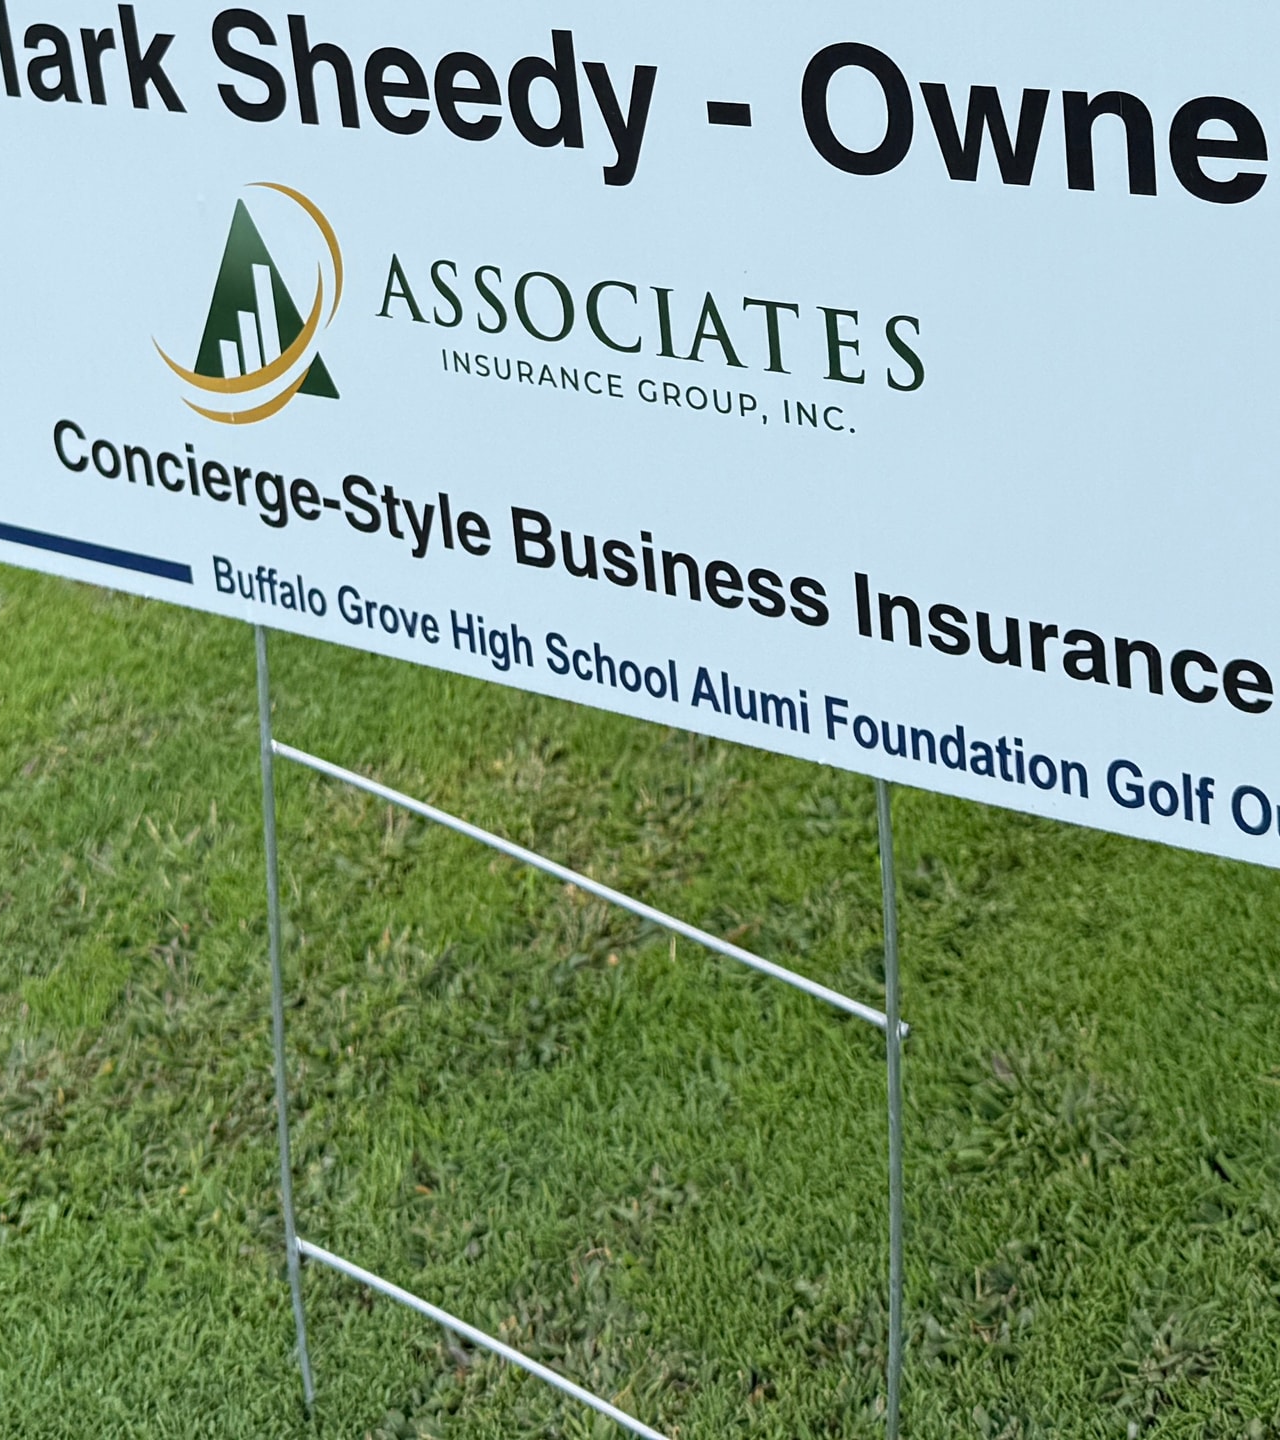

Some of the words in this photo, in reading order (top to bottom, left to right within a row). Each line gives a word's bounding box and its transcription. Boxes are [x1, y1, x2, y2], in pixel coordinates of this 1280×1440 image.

[212, 8, 657, 186] Sheedy
[707, 101, 752, 127] -
[376, 254, 924, 391] ASSOCIATES
[442, 349, 623, 398] INSURANCE
[638, 379, 767, 424] GROUP,
[784, 400, 856, 434] INC.
[54, 420, 491, 558] Concierge-Style
[511, 506, 829, 626] Business
[855, 572, 1273, 714] Insurance
[213, 555, 327, 616] Buffalo
[338, 585, 439, 644] Grove
[450, 609, 533, 671] High
[546, 632, 678, 702] School
[691, 667, 809, 734] Alumi
[825, 695, 1088, 798] Foundation
[1107, 759, 1214, 825] Golf
